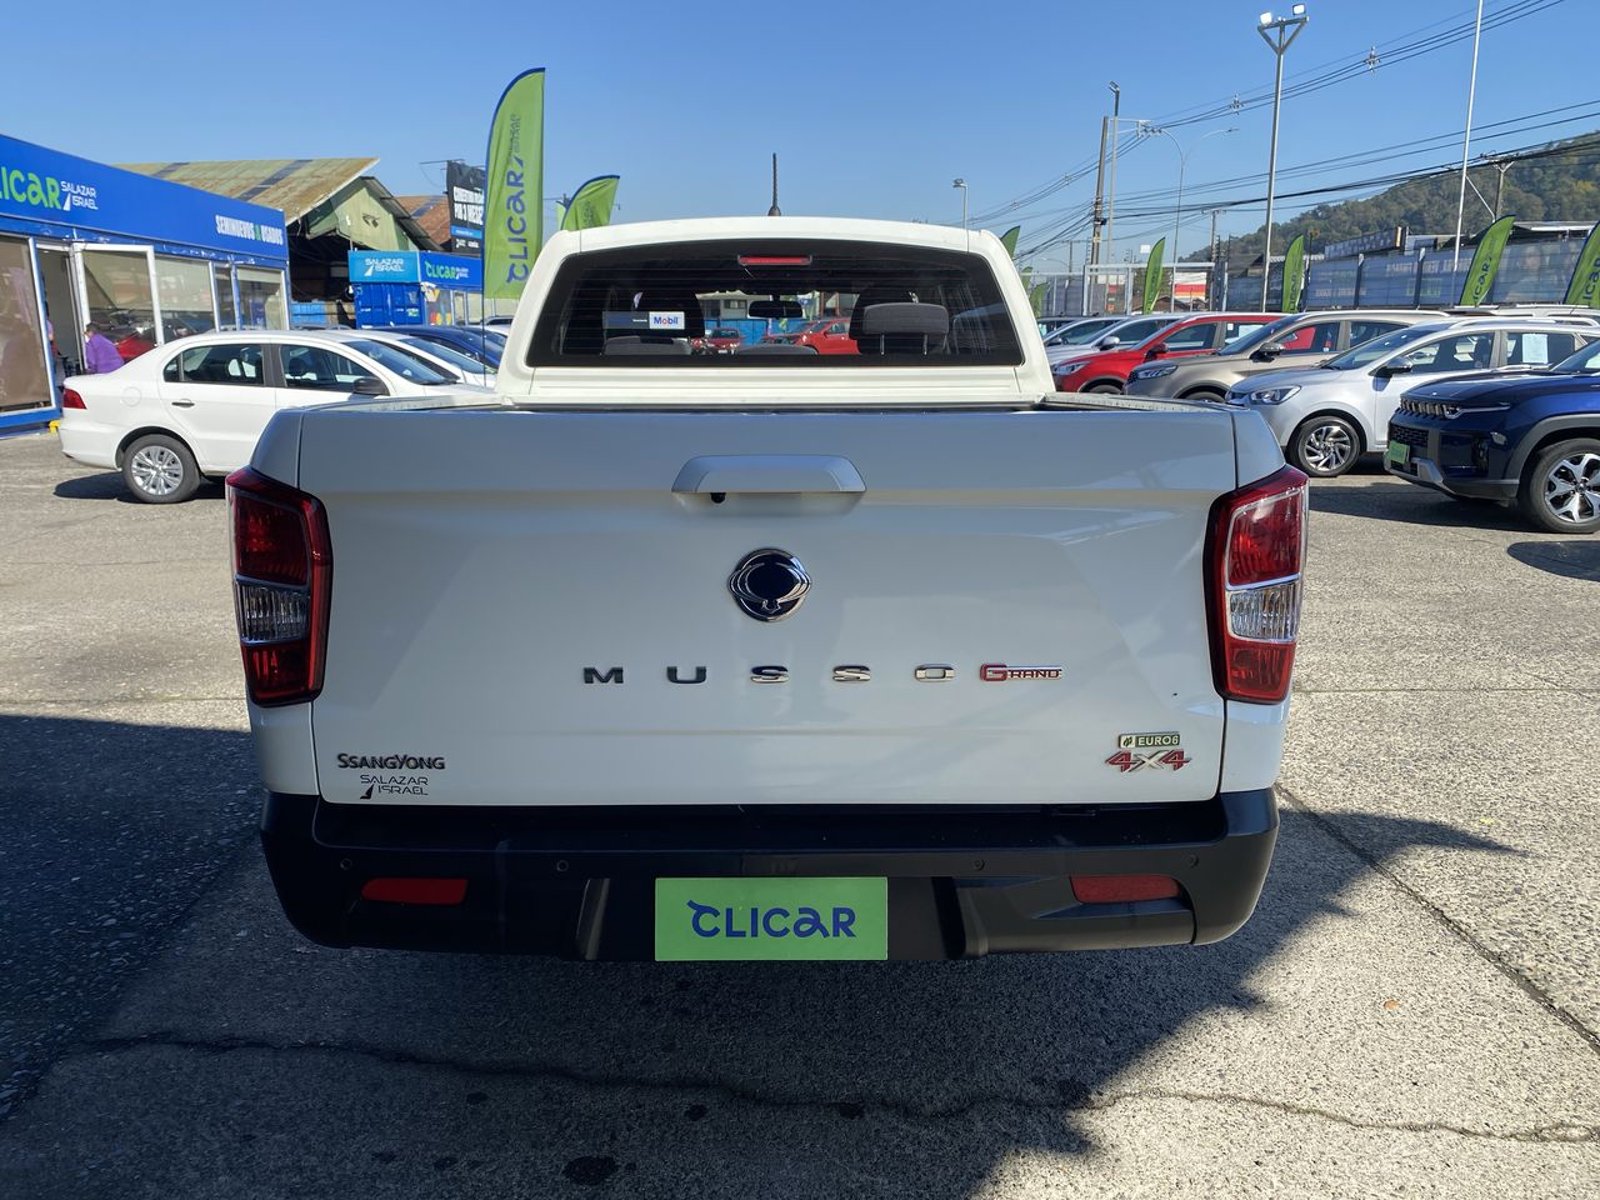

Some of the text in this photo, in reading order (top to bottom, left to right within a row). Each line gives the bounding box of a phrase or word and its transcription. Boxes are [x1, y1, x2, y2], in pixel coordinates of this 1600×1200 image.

[60, 180, 97, 198] SALAZAR
[72, 195, 99, 210] ISRAEL
[653, 316, 679, 325] Mobil
[583, 663, 1062, 685] MUSSO GRAND
[1138, 735, 1179, 746] EURO6
[360, 774, 429, 785] SALAZAR
[378, 785, 429, 796] ISRAEL
